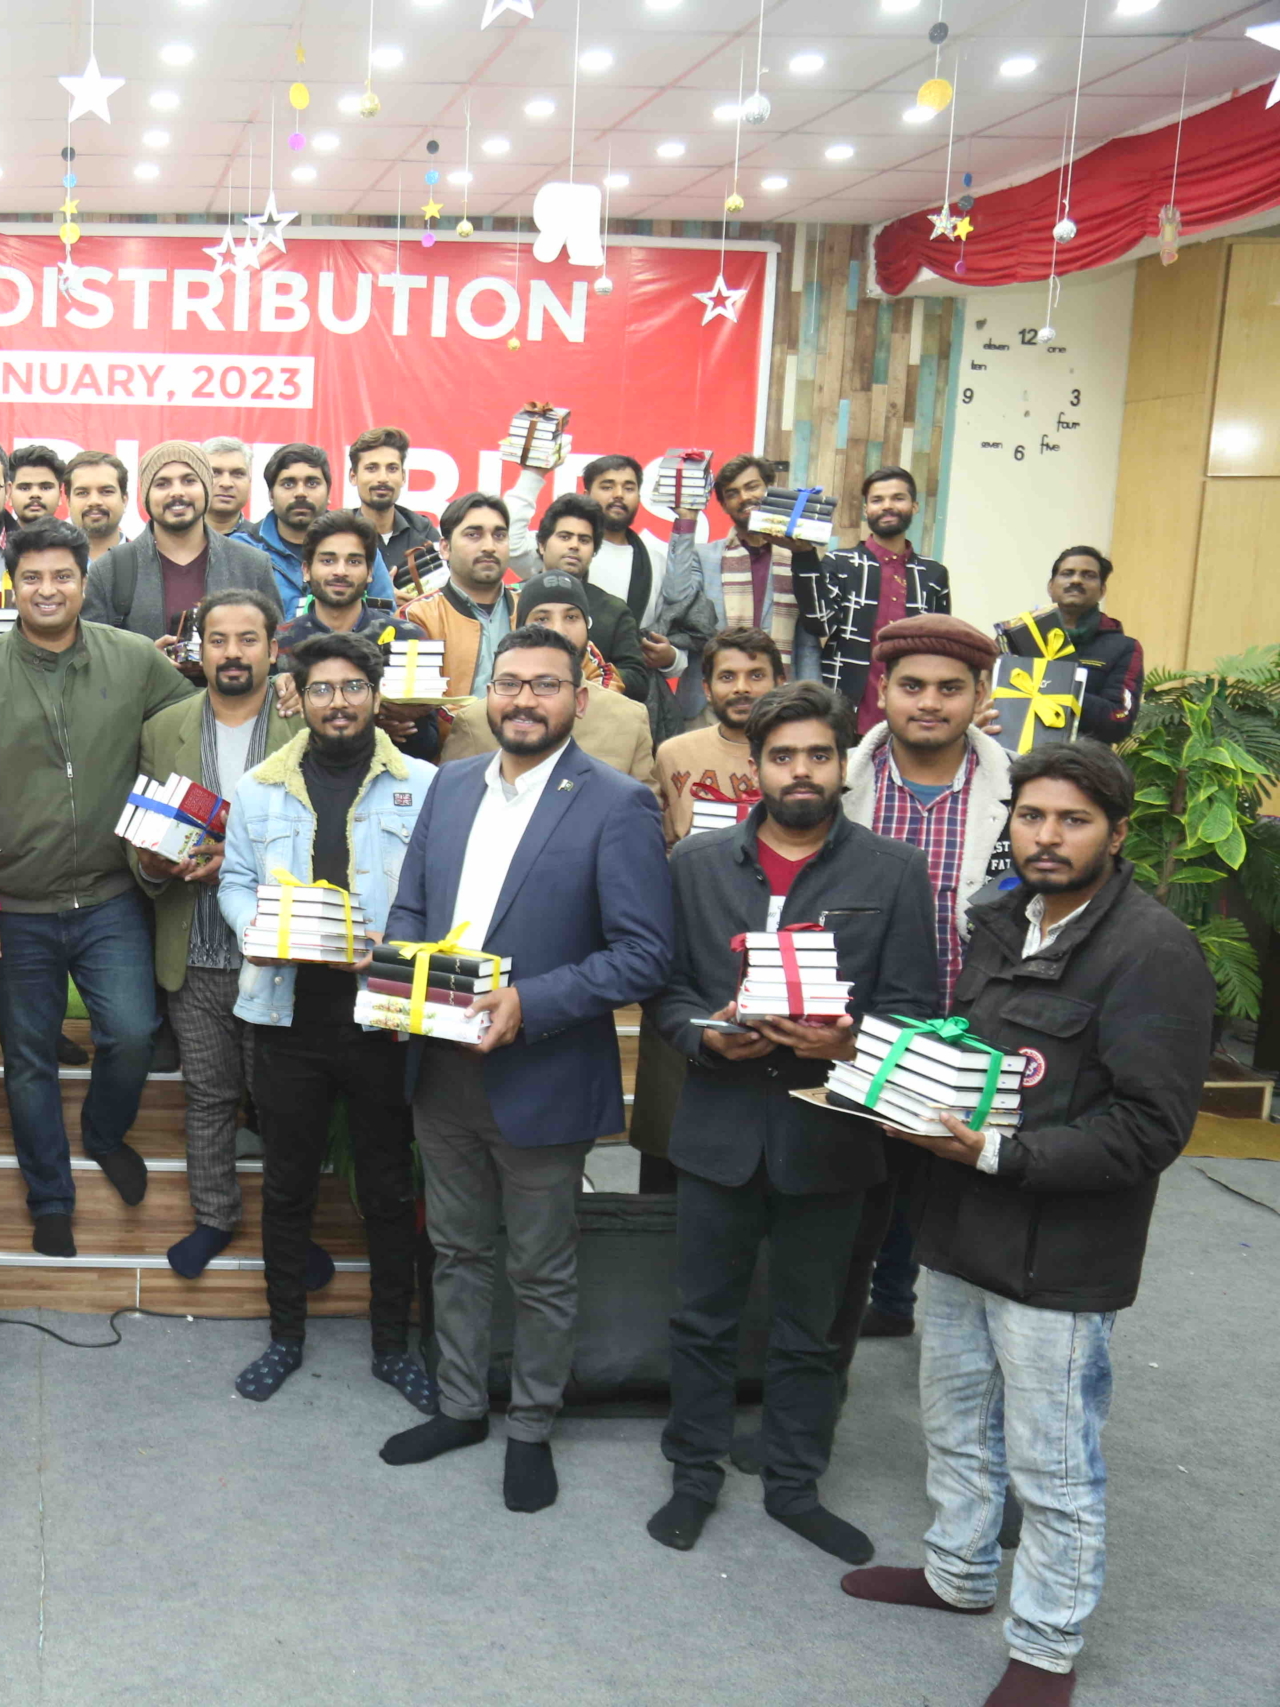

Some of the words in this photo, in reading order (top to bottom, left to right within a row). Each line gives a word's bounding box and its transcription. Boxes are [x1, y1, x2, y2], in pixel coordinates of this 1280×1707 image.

[1018, 328, 1038, 345] 12
[1046, 345, 1067, 354] one
[191, 365, 302, 401] 2023
[962, 387, 974, 404] 9
[1070, 388, 1081, 407] 3
[1056, 411, 1081, 433] four
[1013, 444, 1025, 461] 6
[1040, 434, 1061, 455] five
[991, 841, 1011, 854] ST
